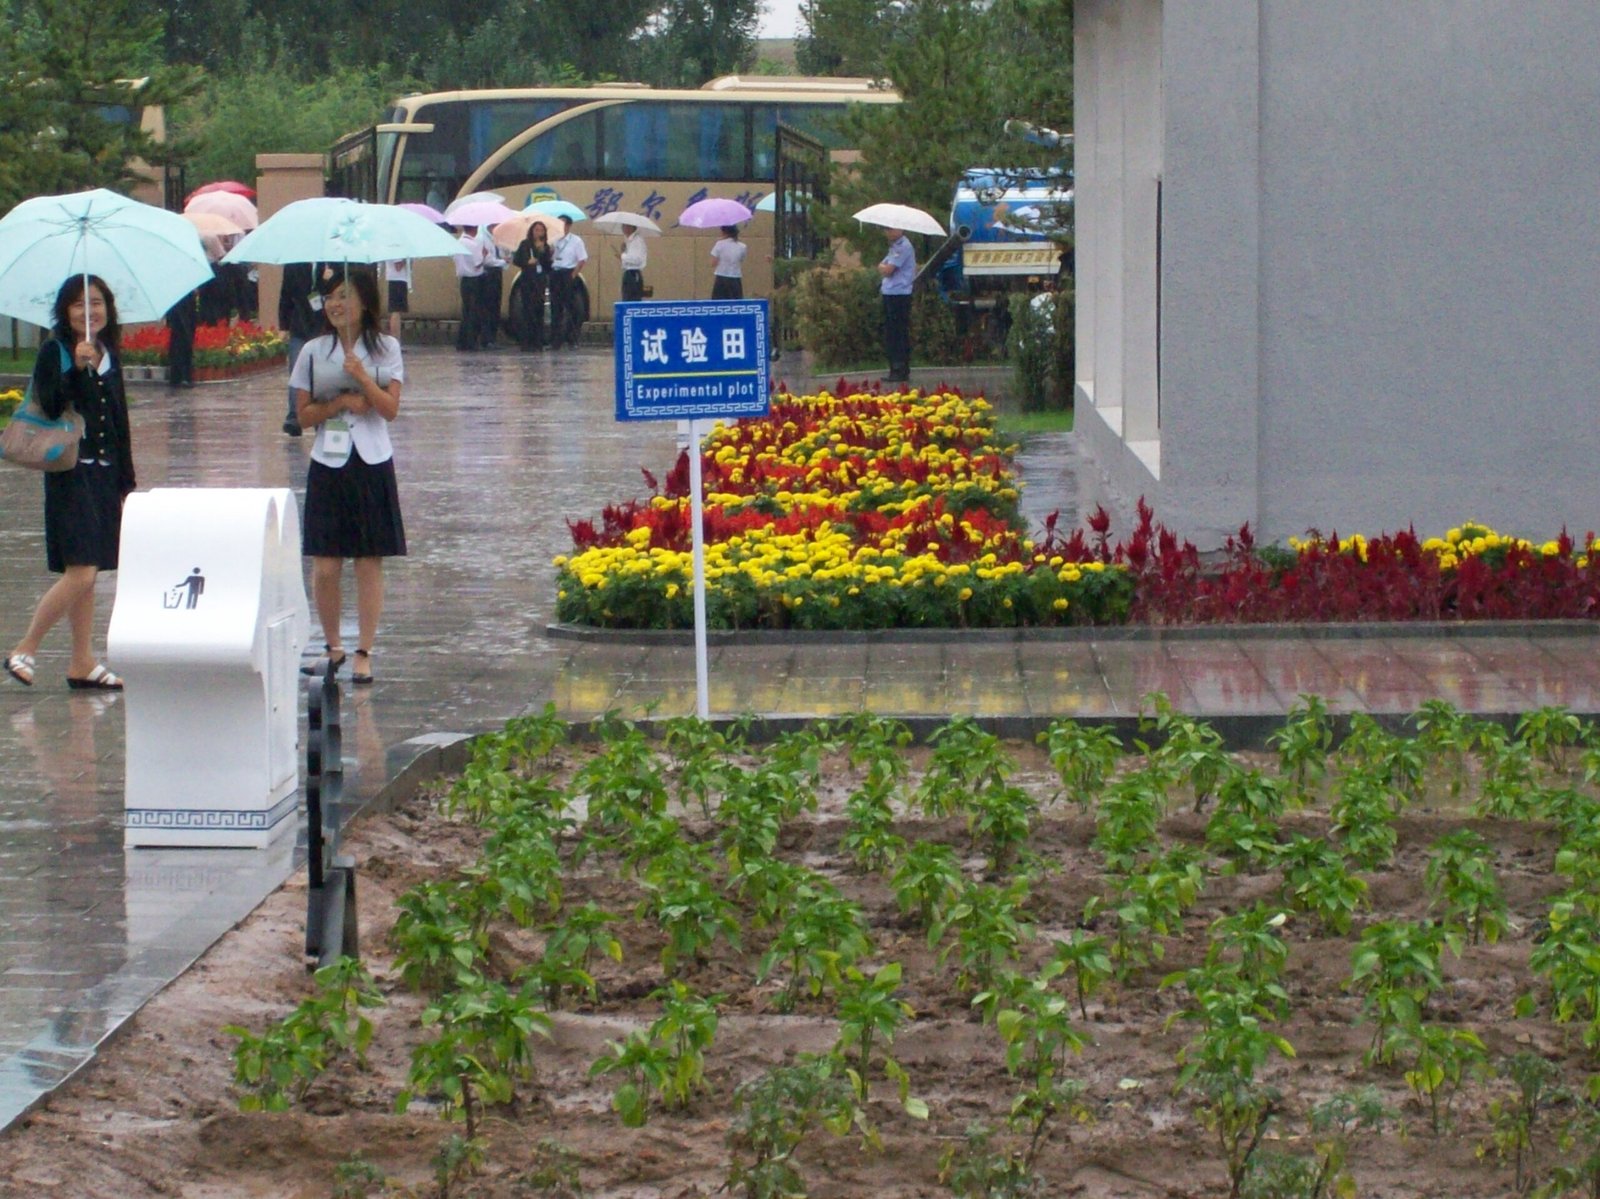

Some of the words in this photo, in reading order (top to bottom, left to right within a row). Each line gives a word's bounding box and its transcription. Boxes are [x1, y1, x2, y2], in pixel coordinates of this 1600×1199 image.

[641, 327, 745, 364] 试验田
[637, 382, 723, 401] Experimental
[728, 381, 754, 398] plot
